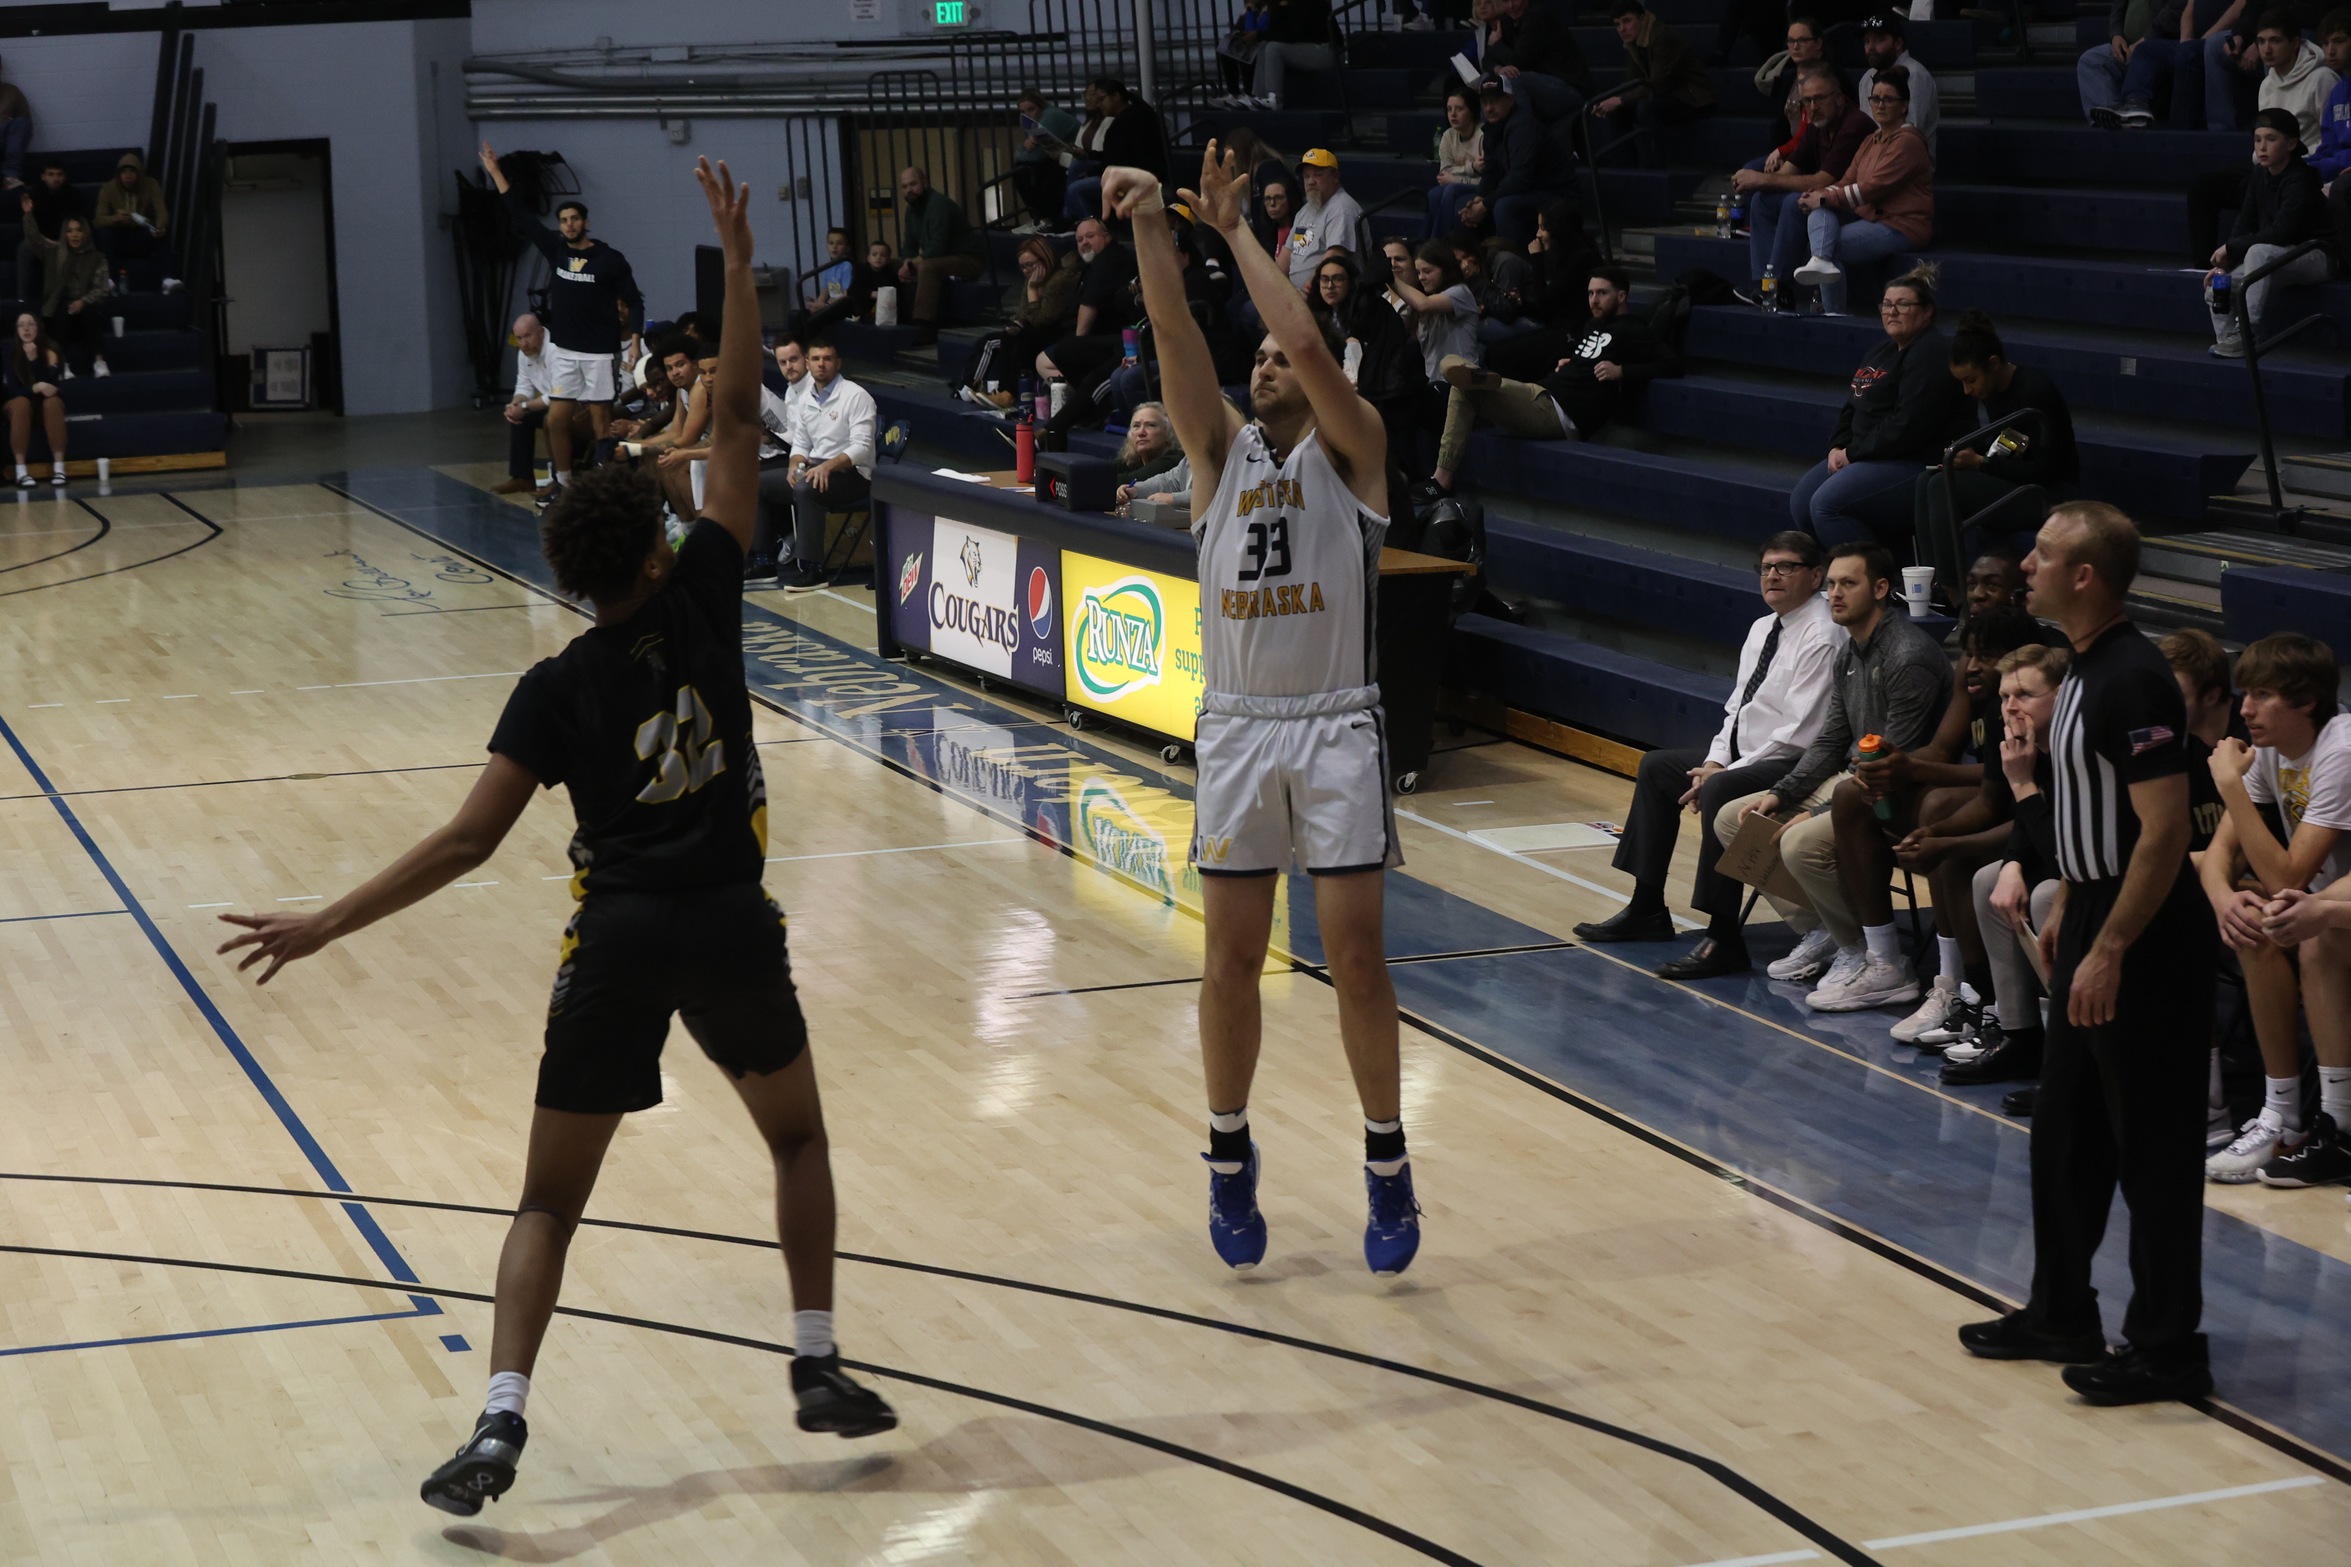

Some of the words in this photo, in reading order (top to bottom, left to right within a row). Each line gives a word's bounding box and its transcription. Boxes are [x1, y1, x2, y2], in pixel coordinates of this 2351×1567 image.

[936, 1, 964, 24] EXIT
[1055, 480, 1068, 499] POSS
[1236, 478, 1305, 517] WSTERN
[1238, 516, 1292, 581] 33
[930, 581, 1018, 656] COUGARS
[1221, 581, 1325, 621] NEBRASKA
[1086, 595, 1158, 677] RUNZA
[1032, 646, 1053, 667] pepsi
[633, 683, 727, 805] 32
